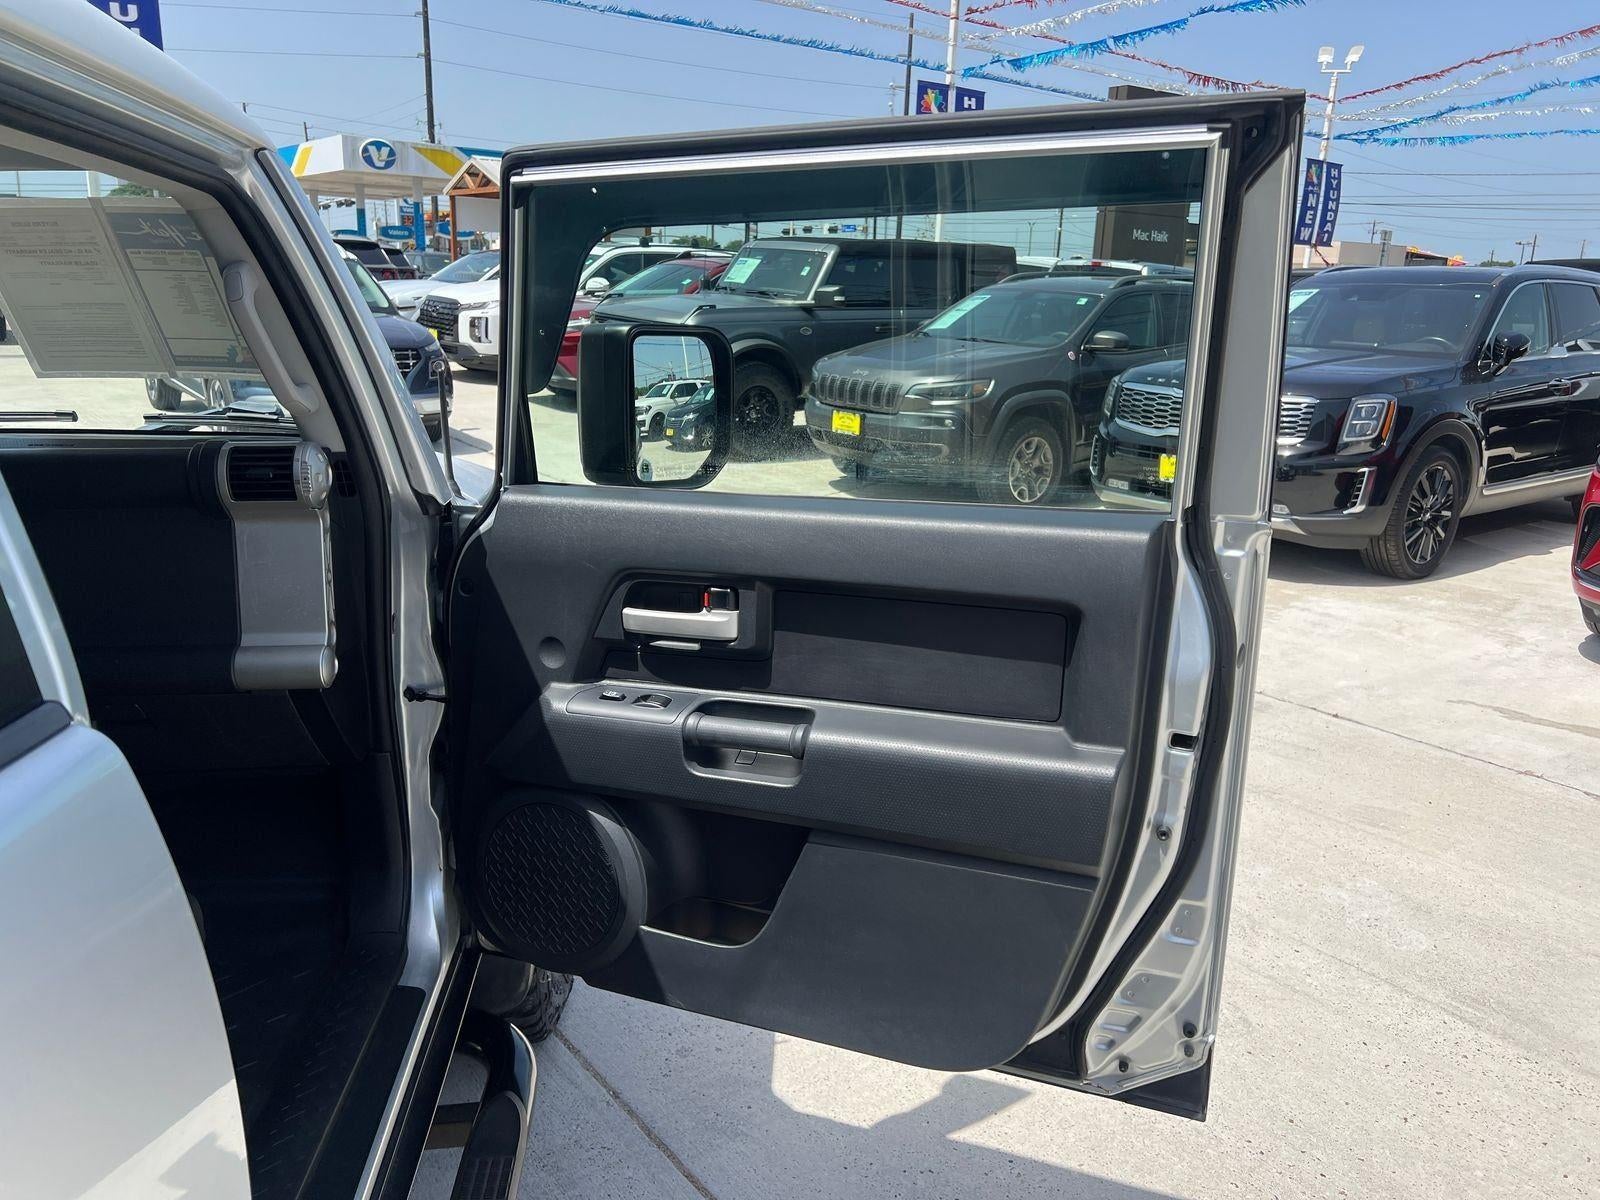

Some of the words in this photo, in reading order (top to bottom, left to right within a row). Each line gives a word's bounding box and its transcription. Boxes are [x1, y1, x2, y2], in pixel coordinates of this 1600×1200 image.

[1300, 193, 1318, 241] NEW
[1322, 168, 1339, 242] HYUNDAI
[388, 229, 409, 237] Valero
[1132, 229, 1150, 241] Mac
[1150, 230, 1168, 242] Haik
